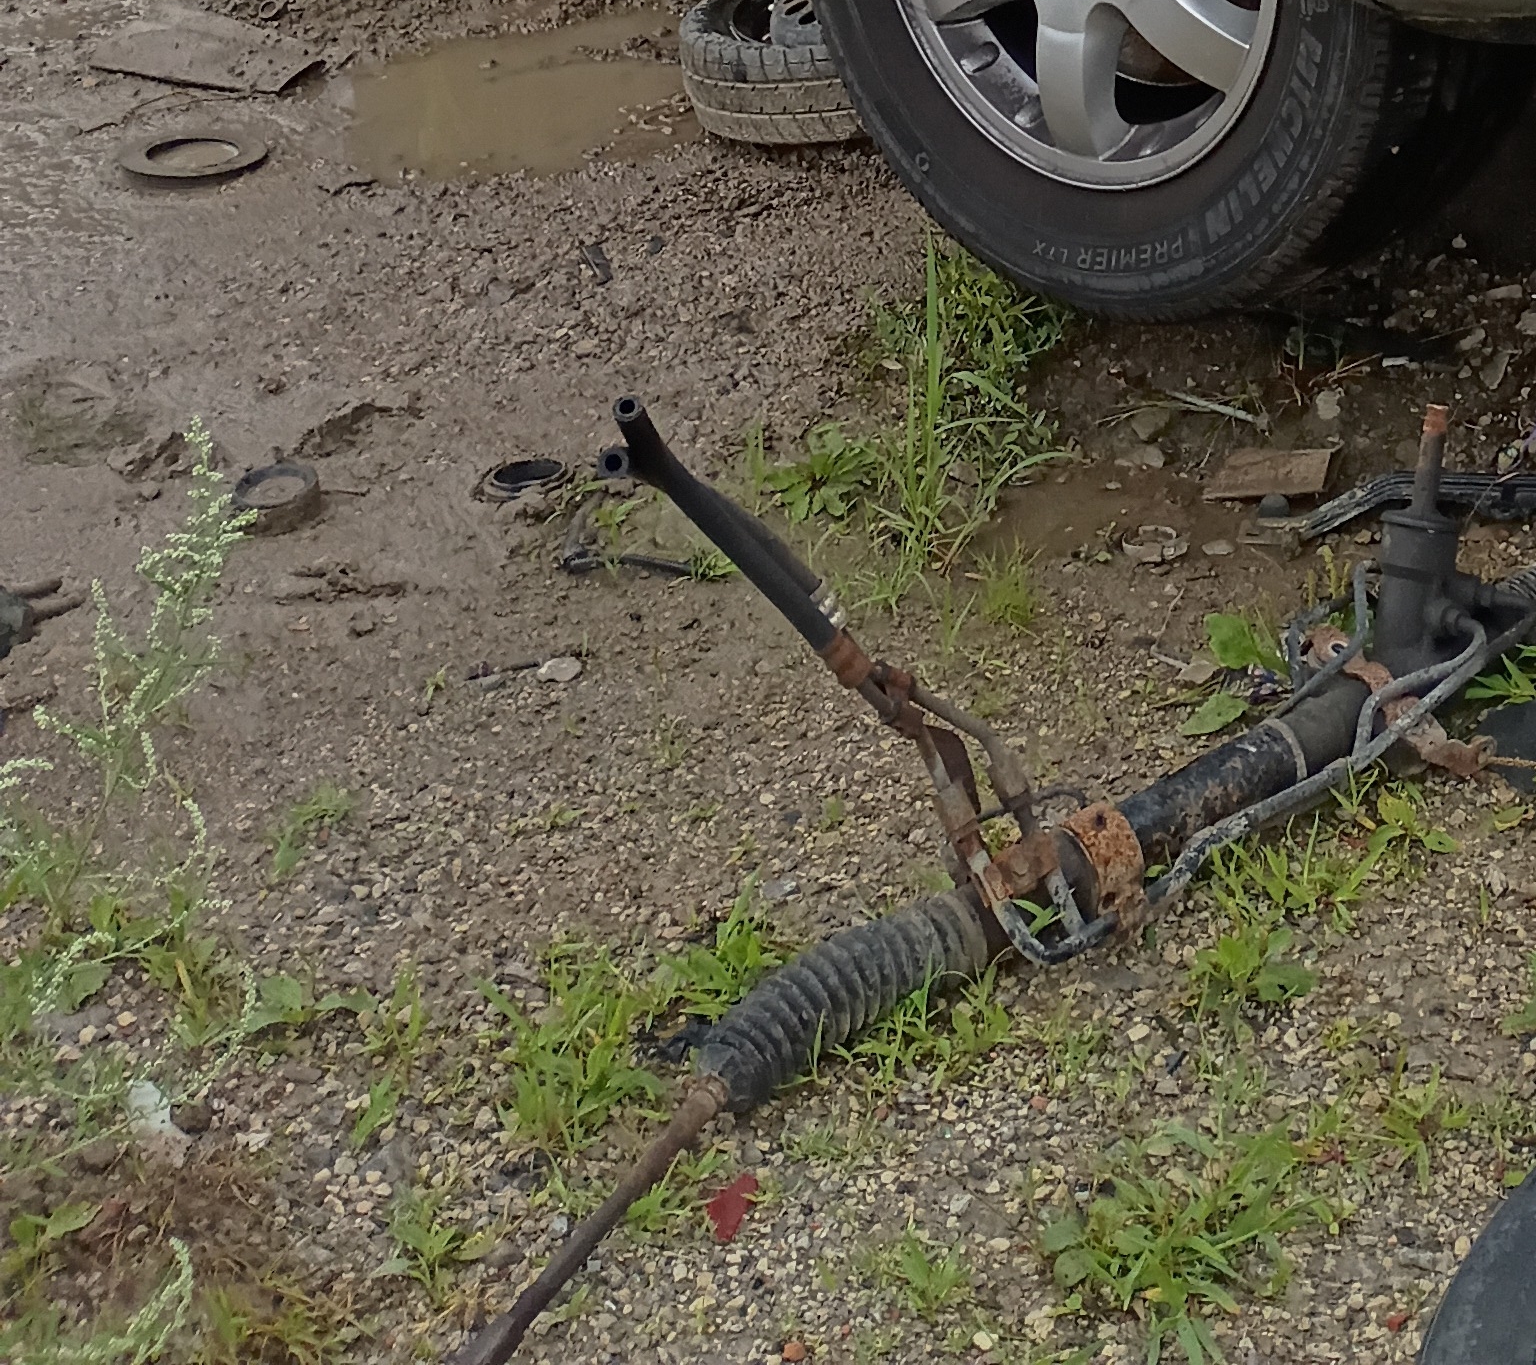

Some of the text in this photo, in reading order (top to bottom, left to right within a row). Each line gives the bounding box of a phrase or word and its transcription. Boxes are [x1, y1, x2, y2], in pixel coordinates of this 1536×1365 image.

[1203, 25, 1323, 245] MICHELIN
[1032, 233, 1184, 270] PREMIER LTX
